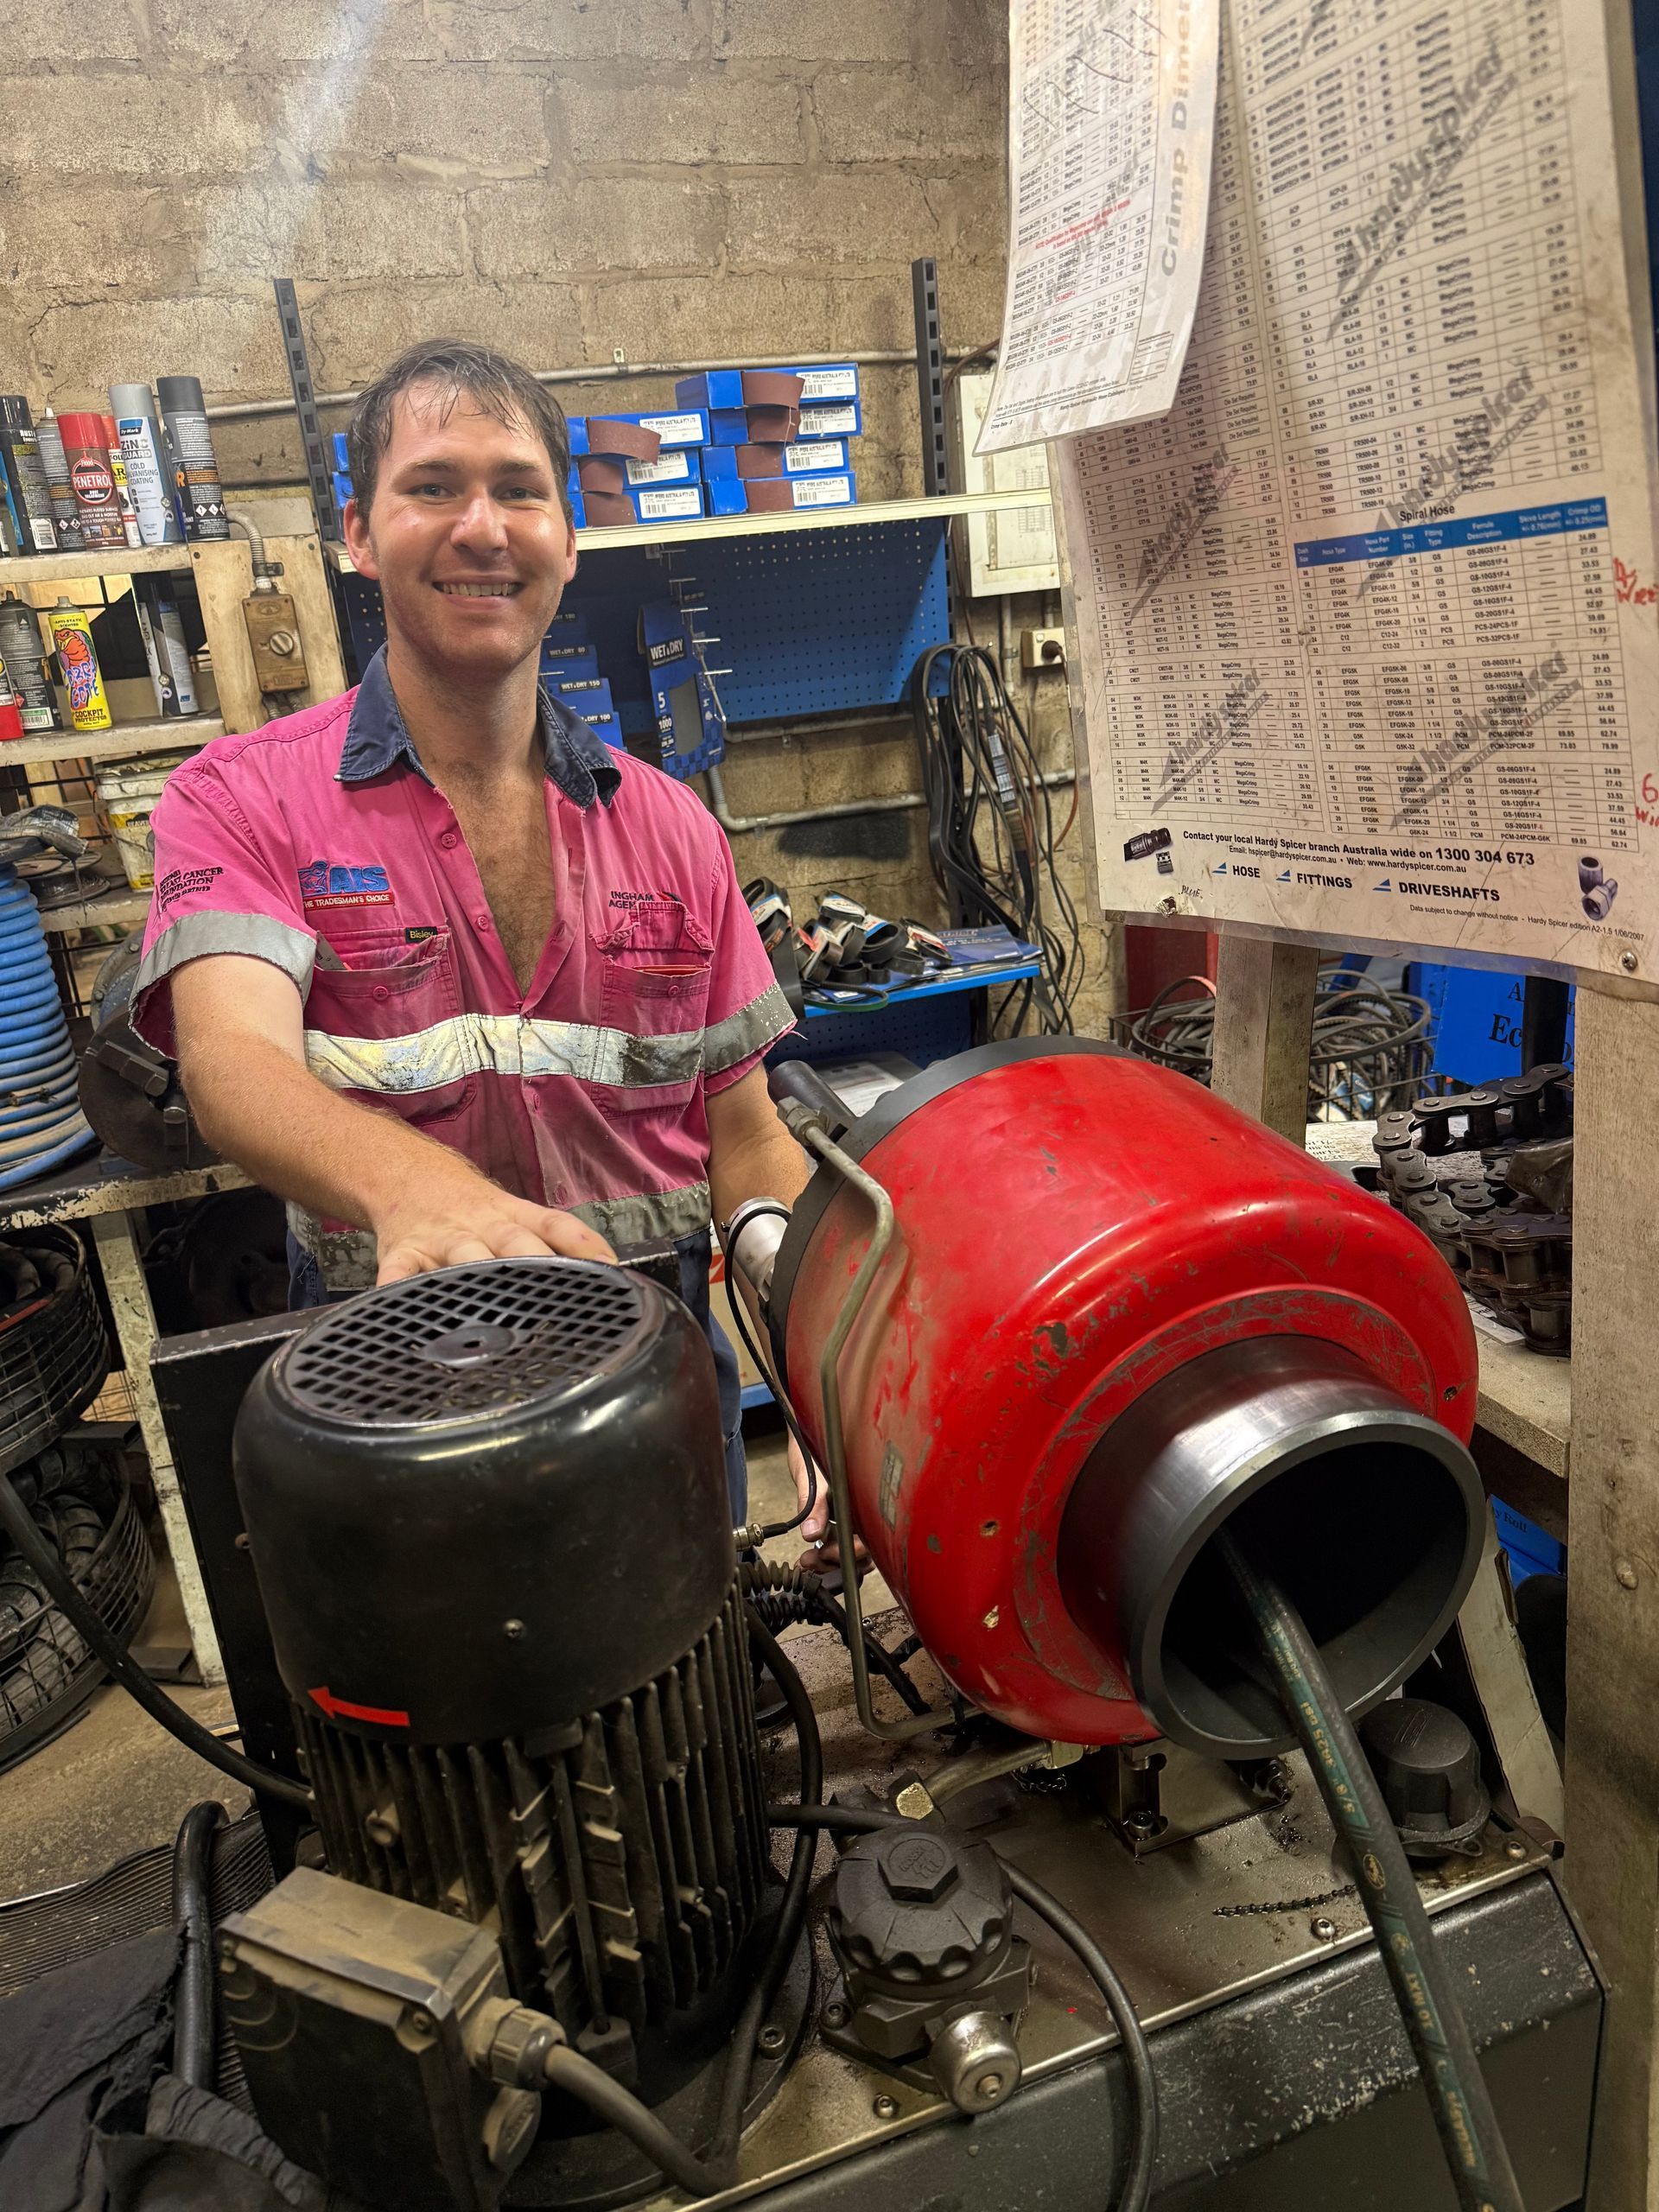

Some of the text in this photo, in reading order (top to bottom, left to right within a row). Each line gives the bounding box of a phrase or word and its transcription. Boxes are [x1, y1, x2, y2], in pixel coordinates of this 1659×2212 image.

[1161, 148, 1188, 276] Crimp
[122, 450, 151, 460] GUARD
[73, 474, 112, 488] PENETROL
[1400, 504, 1455, 522] Spiral Hose
[658, 692, 666, 709] 5
[74, 709, 104, 718] COCKPIT
[658, 719, 671, 729] 1000
[1643, 772, 1659, 804] 6
[1183, 830, 1535, 866] Contact your local Hardy Spicer branch Australia wide on 1300 304 673
[1229, 845, 1466, 874] Email: hspicer@hardyspicer.com.au Web: www.hardyspicer.com.au
[183, 866, 224, 880] CANCER
[1232, 865, 1500, 902] HOSE FITTINGS DRIVESHAFTS
[315, 895, 364, 907] TRADESMAN'S
[365, 893, 390, 902] CHOICE
[611, 891, 654, 901] INGHAM
[1424, 906, 1446, 916] subject
[1446, 907, 1452, 916] to
[1453, 909, 1475, 918] change
[1476, 911, 1497, 919] without
[1497, 913, 1518, 922] notice
[1528, 916, 1547, 927] Hardy
[1548, 918, 1568, 929] Spicer
[1569, 922, 1591, 931] edition
[1591, 925, 1612, 935] A2-1.5
[410, 931, 434, 939] Bisley
